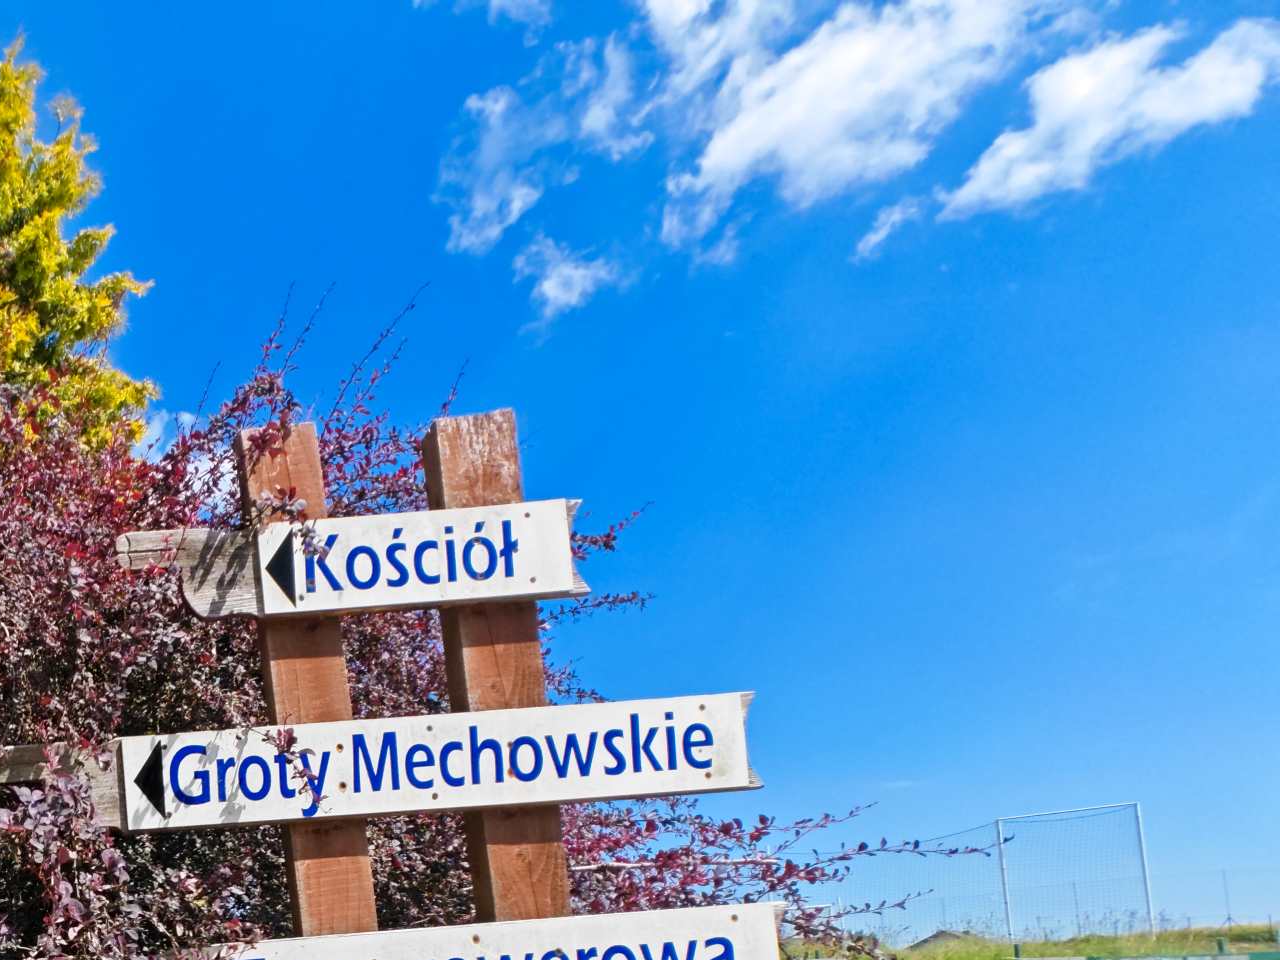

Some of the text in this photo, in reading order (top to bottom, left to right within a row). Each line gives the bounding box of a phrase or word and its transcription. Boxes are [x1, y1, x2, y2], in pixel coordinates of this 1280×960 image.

[304, 519, 518, 593] Kościół
[170, 711, 714, 817] Groty Mechowskie
